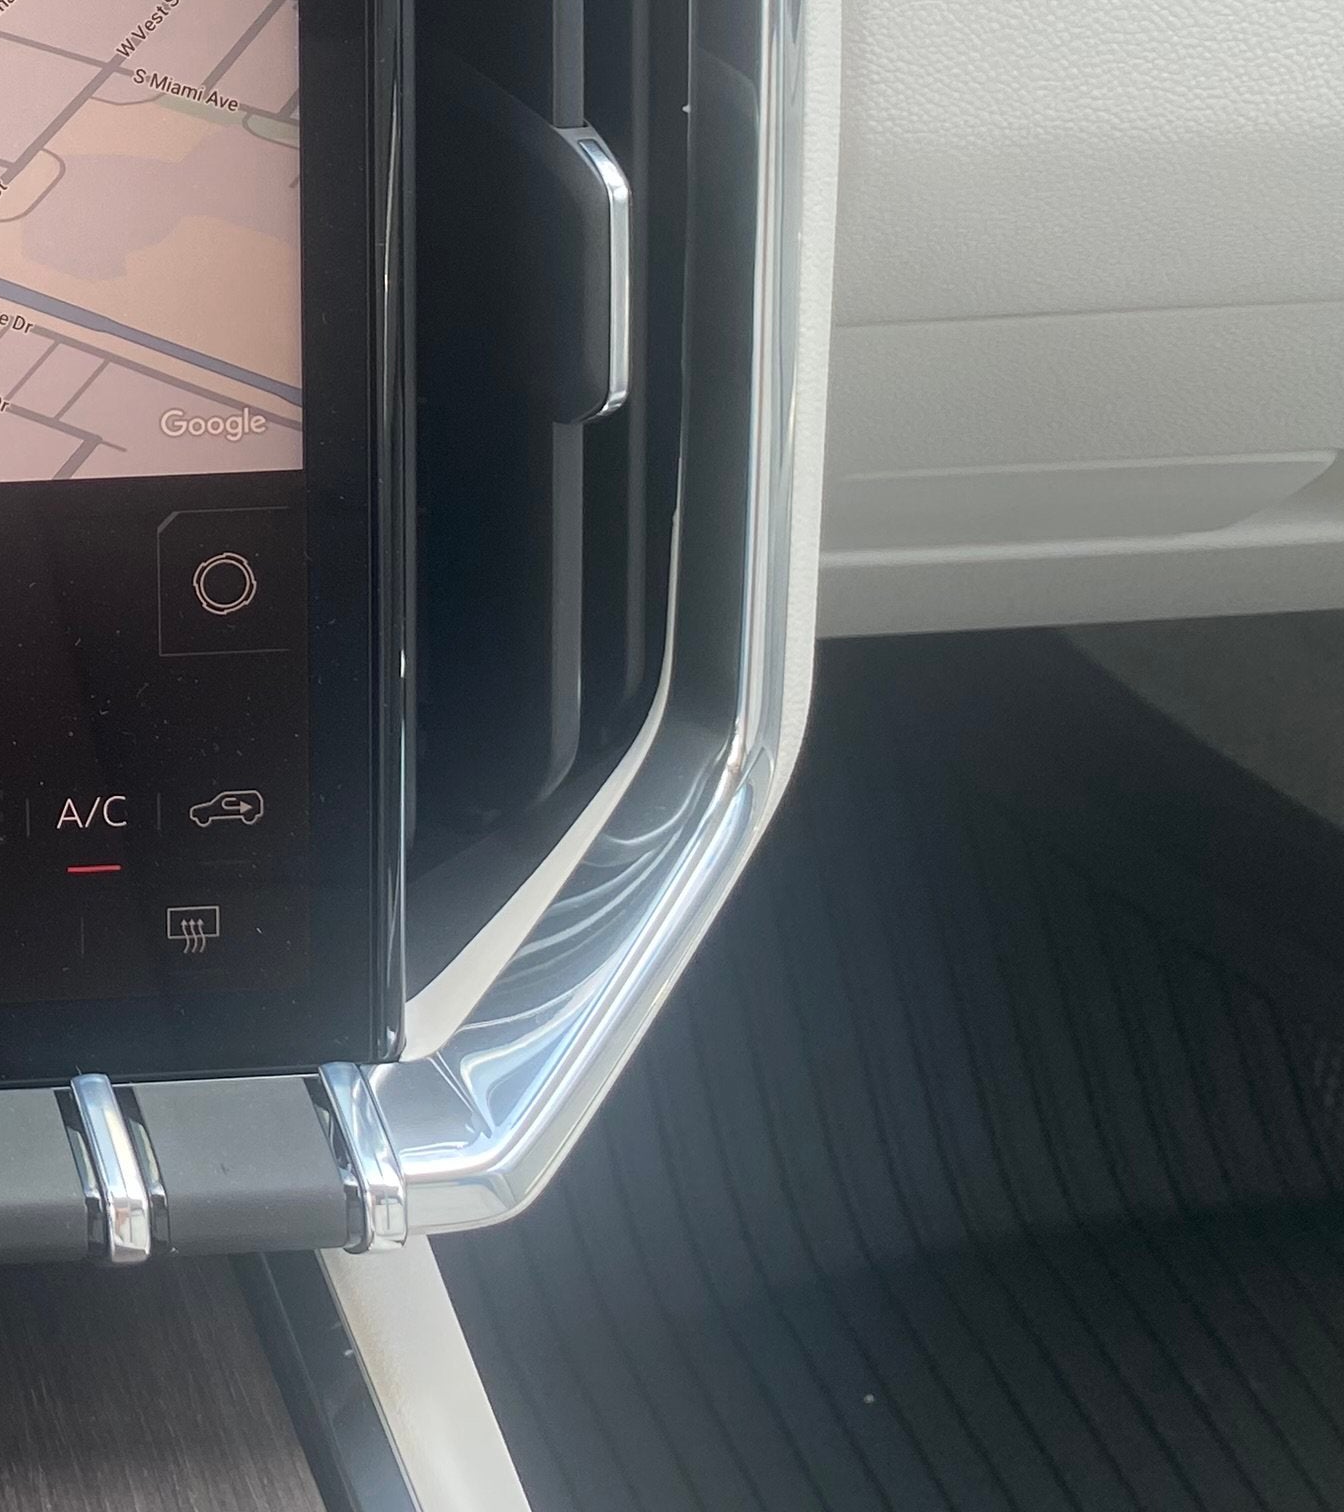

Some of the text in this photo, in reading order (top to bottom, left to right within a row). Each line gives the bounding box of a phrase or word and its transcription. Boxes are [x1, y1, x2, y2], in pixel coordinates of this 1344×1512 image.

[133, 69, 239, 111] S Miami Ave
[12, 317, 34, 334] Dr
[160, 408, 267, 441] Google
[57, 795, 127, 829] A/C
